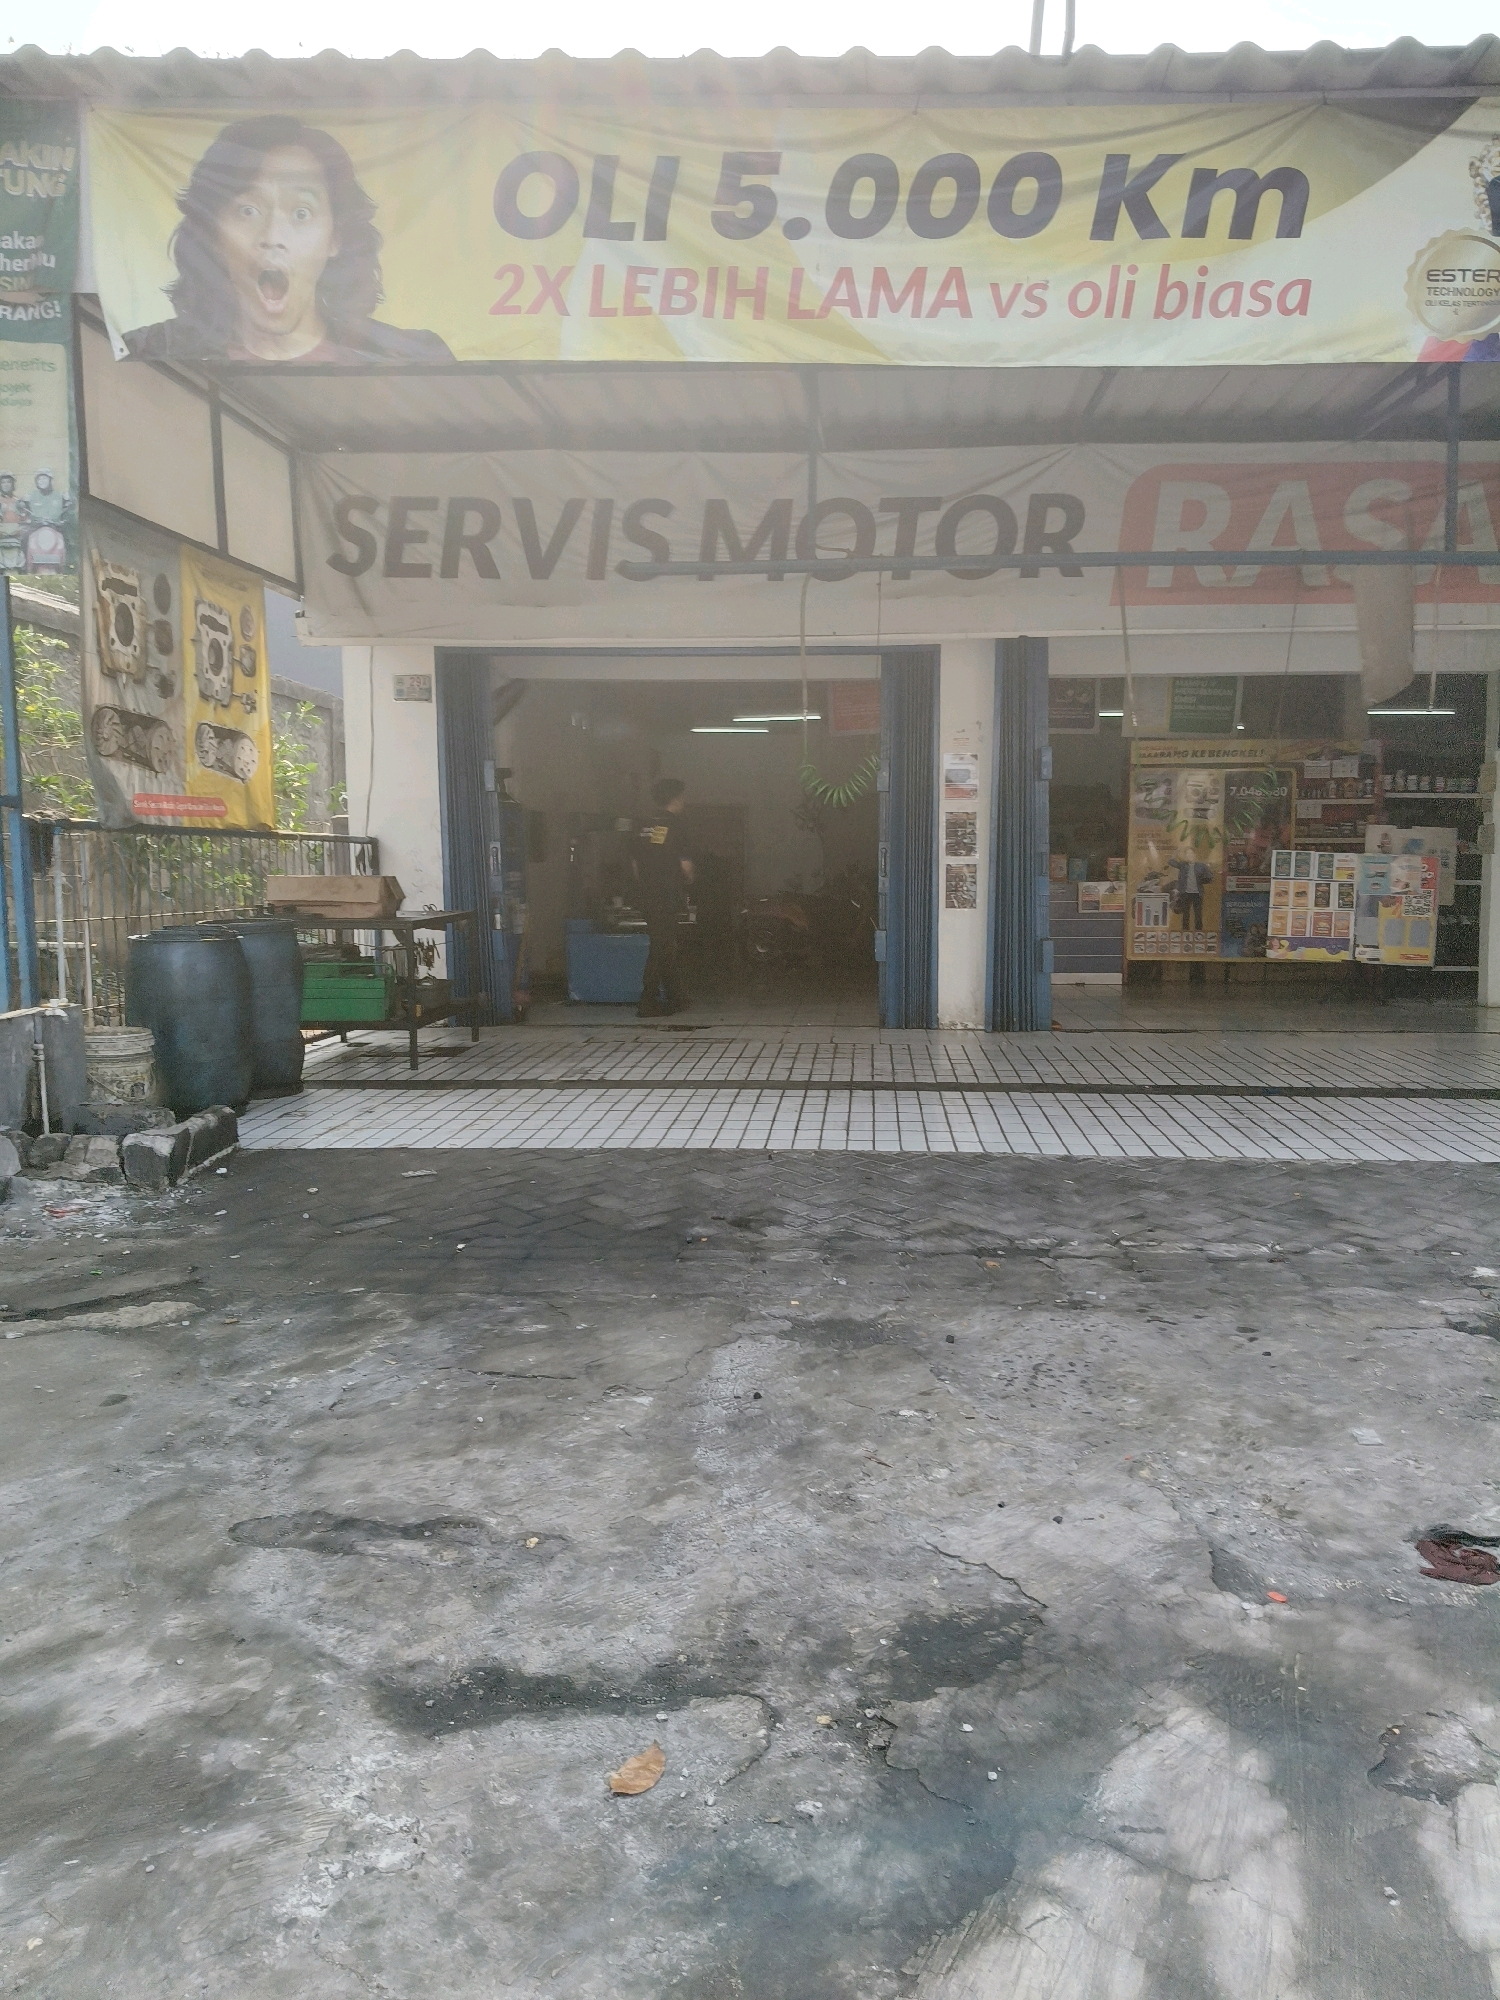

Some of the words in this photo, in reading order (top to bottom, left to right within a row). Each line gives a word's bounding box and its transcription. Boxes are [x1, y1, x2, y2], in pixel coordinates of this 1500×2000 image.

[0, 169, 66, 198] UNG
[493, 150, 681, 242] OLI
[710, 150, 1064, 241] 5.000
[1089, 152, 1311, 241] Km
[1426, 268, 1500, 283] ESTER
[488, 263, 576, 317] 2X
[588, 264, 770, 320] LEBIH
[787, 265, 974, 320] LAMA
[989, 280, 1050, 319] vs
[1067, 263, 1140, 320] oli
[1153, 263, 1313, 321] biasa
[1426, 286, 1500, 297] TECHNOLOGY
[0, 358, 57, 372] enefits
[325, 494, 677, 582] SERVIS
[697, 493, 1087, 582] MOTOR
[1146, 478, 1500, 588] RASA
